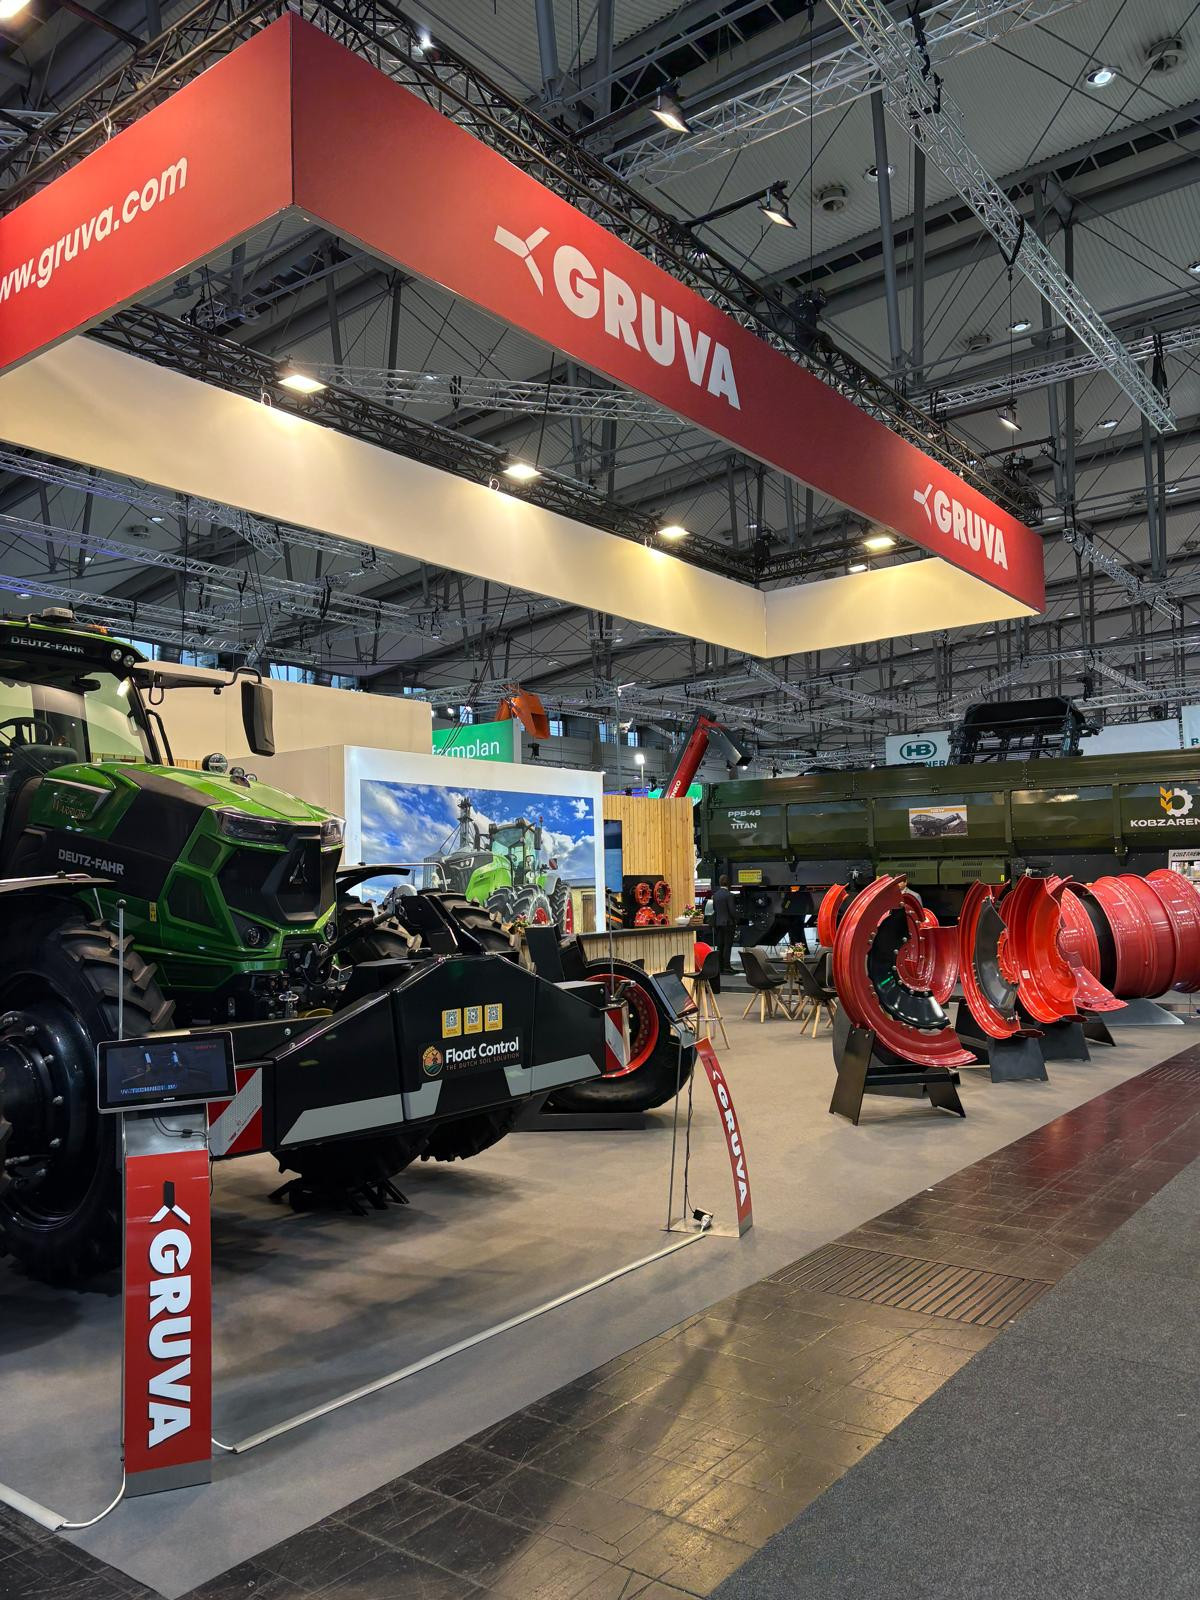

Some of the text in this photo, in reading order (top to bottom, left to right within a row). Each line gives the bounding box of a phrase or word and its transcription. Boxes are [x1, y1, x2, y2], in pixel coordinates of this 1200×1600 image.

[553, 244, 741, 411] GRUVA
[934, 489, 1008, 571] GRUVA
[11, 635, 86, 655] DEUTZ-FAHR
[906, 743, 932, 757] HB
[728, 809, 761, 818] PPB-45
[731, 822, 757, 830] TITAN
[58, 848, 125, 876] DEUTZ-FAHR
[445, 1046, 477, 1063] Float
[478, 1036, 520, 1058] Control
[717, 1082, 748, 1208] GRUVA
[148, 1228, 192, 1449] GRUVA
